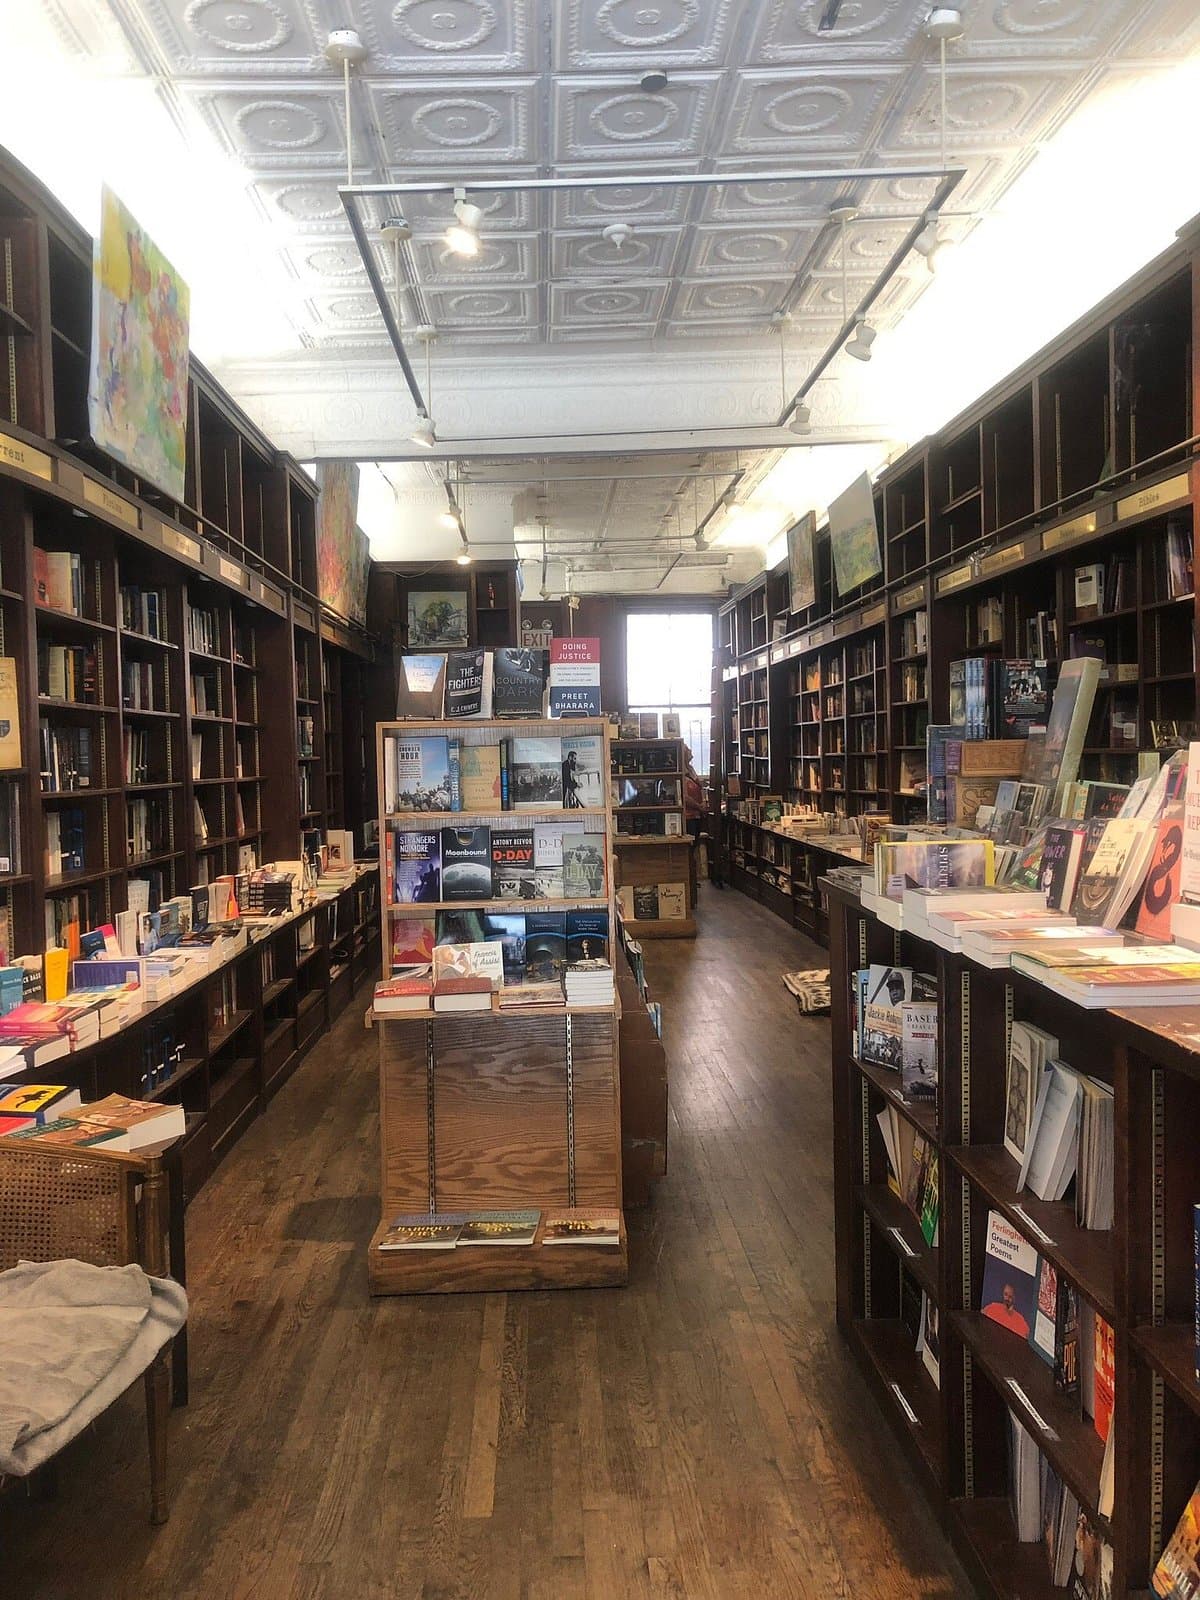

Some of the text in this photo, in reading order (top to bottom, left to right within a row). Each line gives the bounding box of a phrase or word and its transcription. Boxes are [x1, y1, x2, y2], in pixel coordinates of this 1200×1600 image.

[523, 633, 551, 647] EXIT
[460, 666, 475, 678] THE
[448, 675, 482, 690] FIGHTERS
[495, 676, 540, 685] COUNTRY
[495, 686, 540, 697] DARK
[555, 702, 595, 710] BHARARA
[400, 752, 419, 760] HOUR
[399, 835, 436, 845] STRANGERS
[492, 838, 512, 846] ANTONY
[399, 844, 429, 853] NO MORE
[445, 848, 487, 856] Moonbound
[492, 849, 533, 861] D-DAY
[474, 950, 497, 959] Francis
[991, 1232, 1019, 1253] Greatest
[990, 1243, 1013, 1261] Poems
[1064, 1341, 1077, 1382] POE
